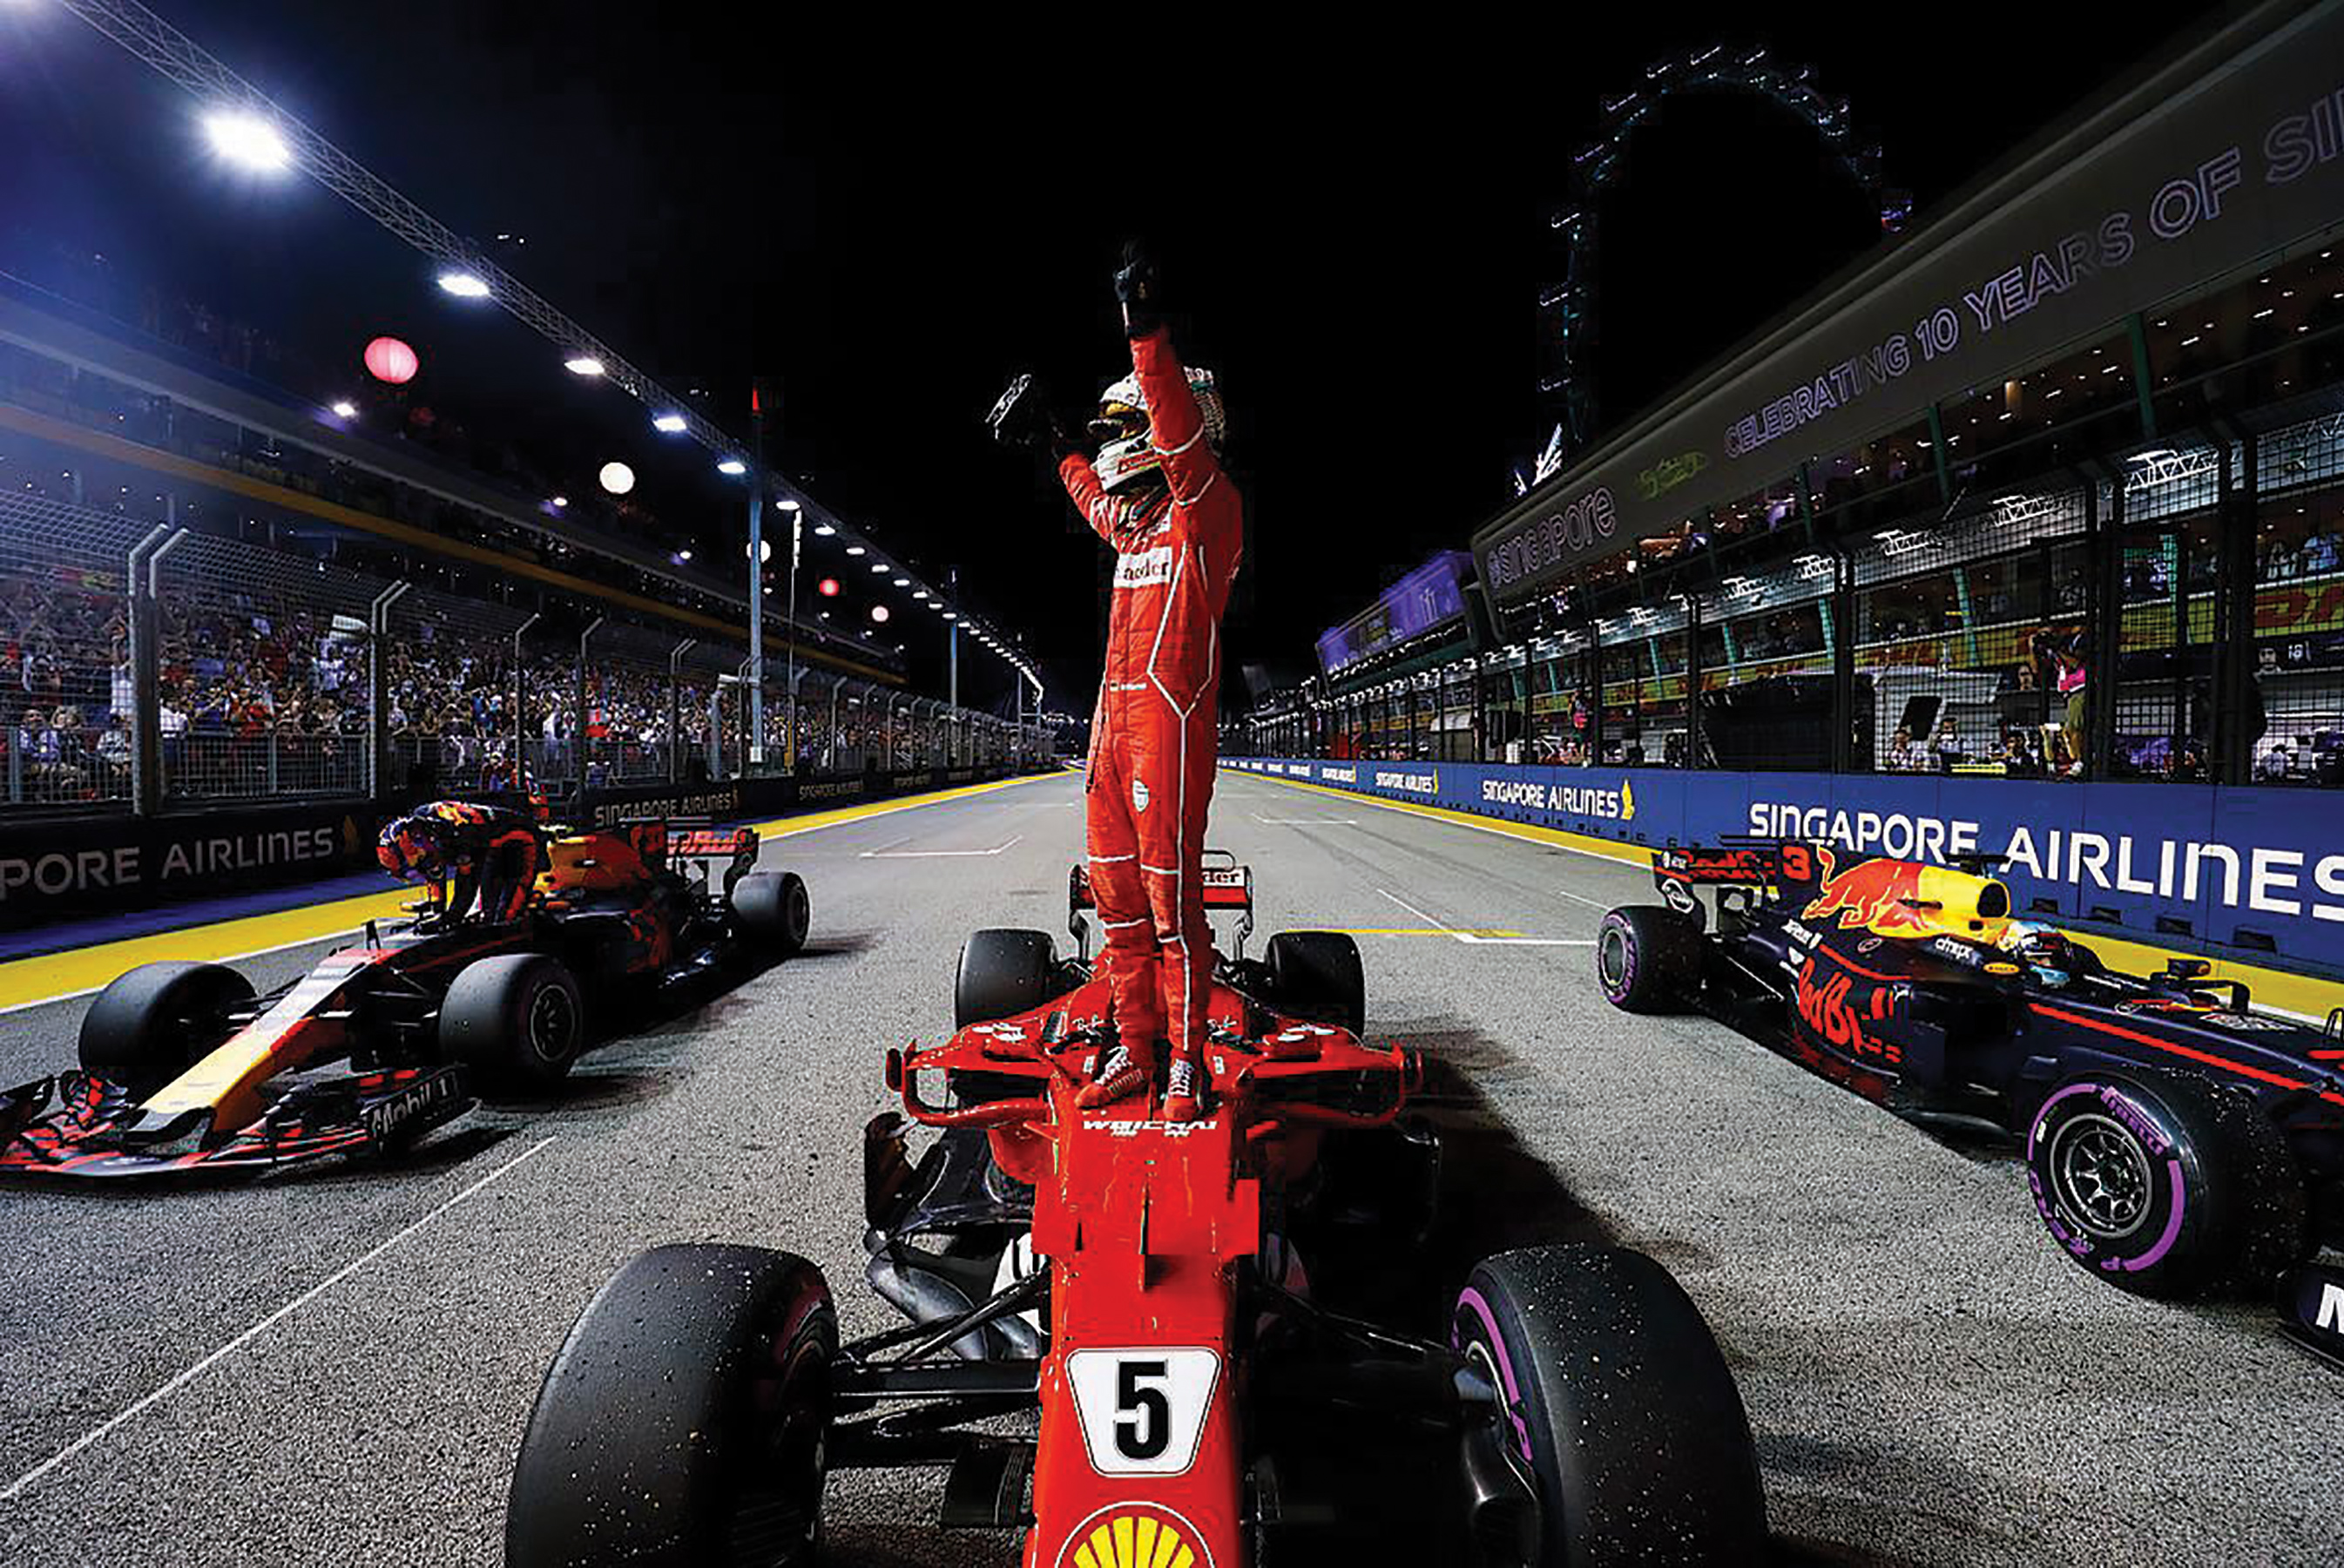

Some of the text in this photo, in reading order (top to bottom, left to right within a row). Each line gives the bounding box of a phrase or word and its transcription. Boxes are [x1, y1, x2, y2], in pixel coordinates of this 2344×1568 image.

[1725, 335, 1912, 458] CELEBRATING
[1916, 308, 1960, 361] 10
[1964, 212, 2135, 331] YEARS
[2149, 147, 2241, 239] OF
[1483, 781, 1618, 818] SINGAPORE AIRLINES
[160, 828, 334, 880] AIRLINES
[1749, 803, 1979, 862] SINGAPORE
[1783, 847, 1811, 880] 3
[1114, 1361, 1170, 1461] 5
